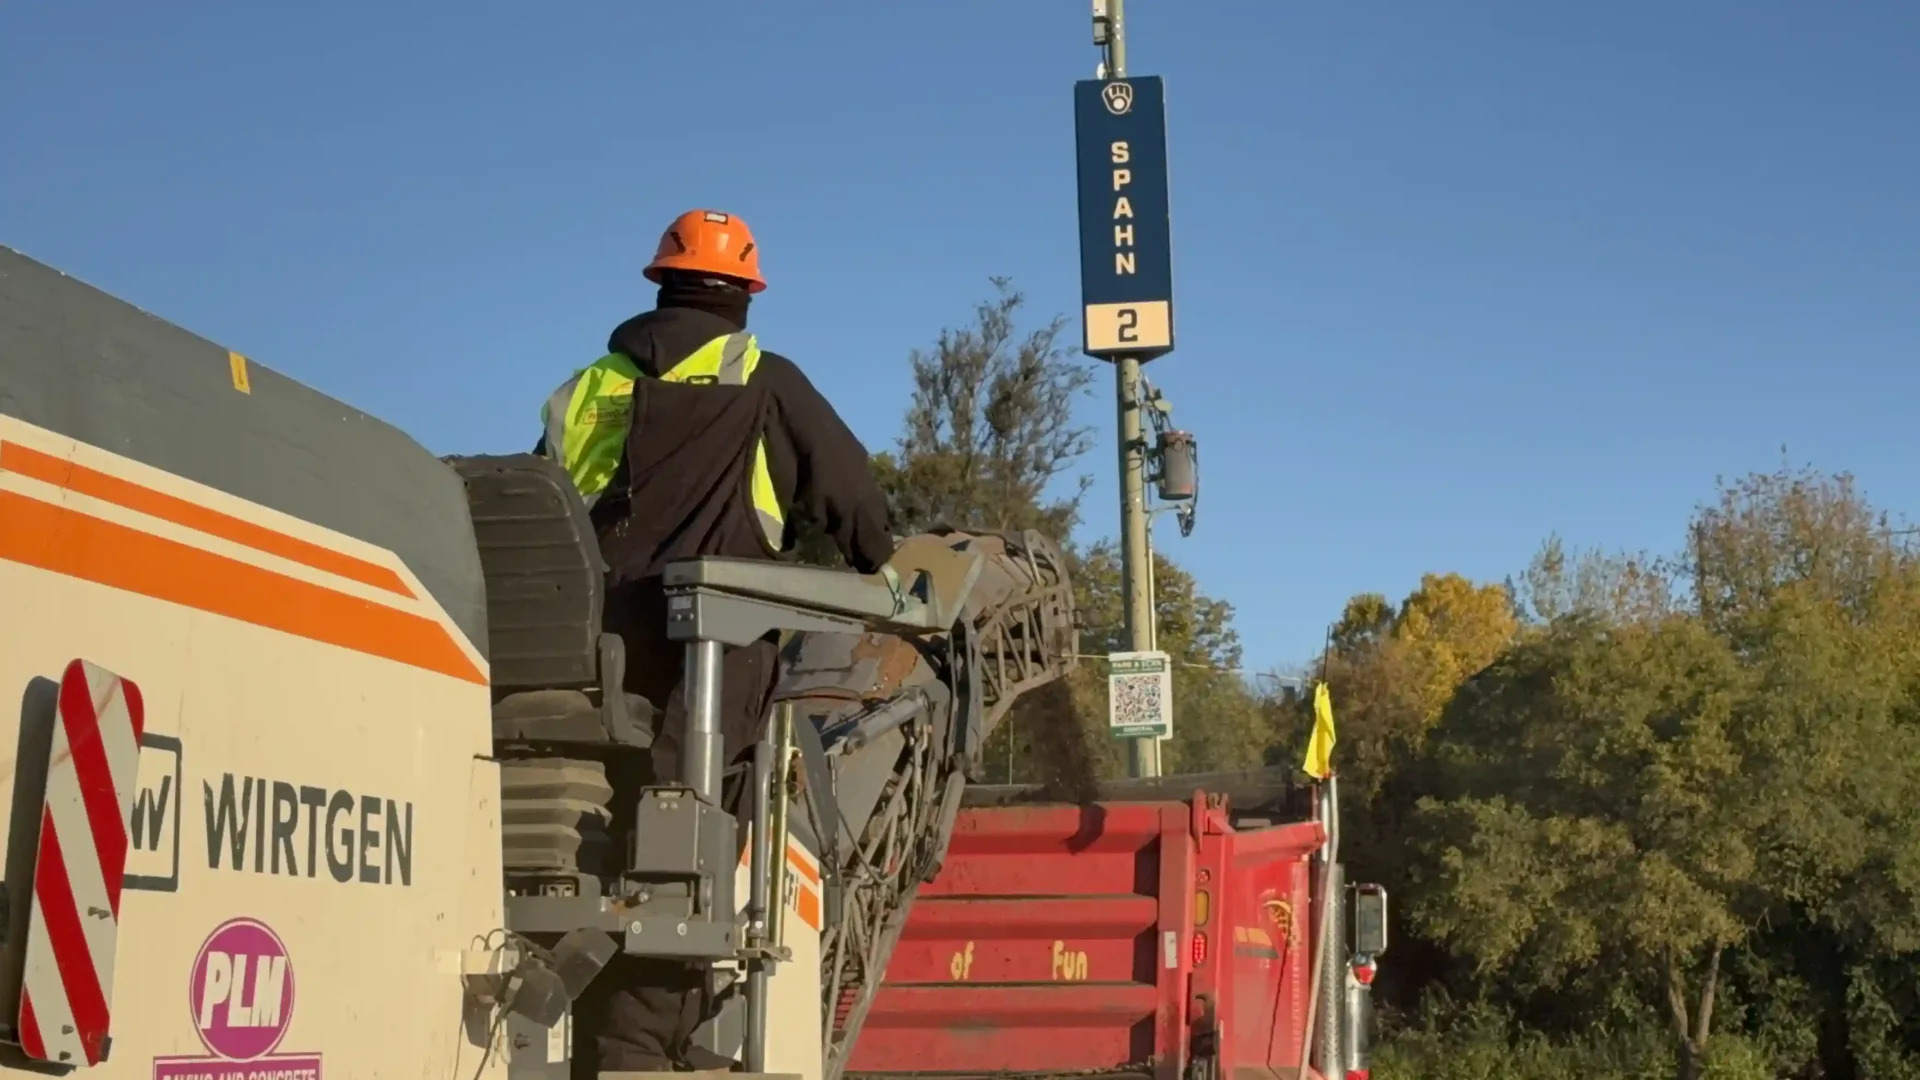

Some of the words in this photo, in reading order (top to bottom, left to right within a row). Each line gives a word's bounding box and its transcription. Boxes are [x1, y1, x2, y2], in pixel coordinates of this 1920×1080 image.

[1111, 141, 1136, 275] SPAHN
[1117, 308, 1139, 343] 2
[202, 772, 413, 886] WIRTGEN
[200, 951, 287, 1029] PLM
[951, 940, 974, 980] of
